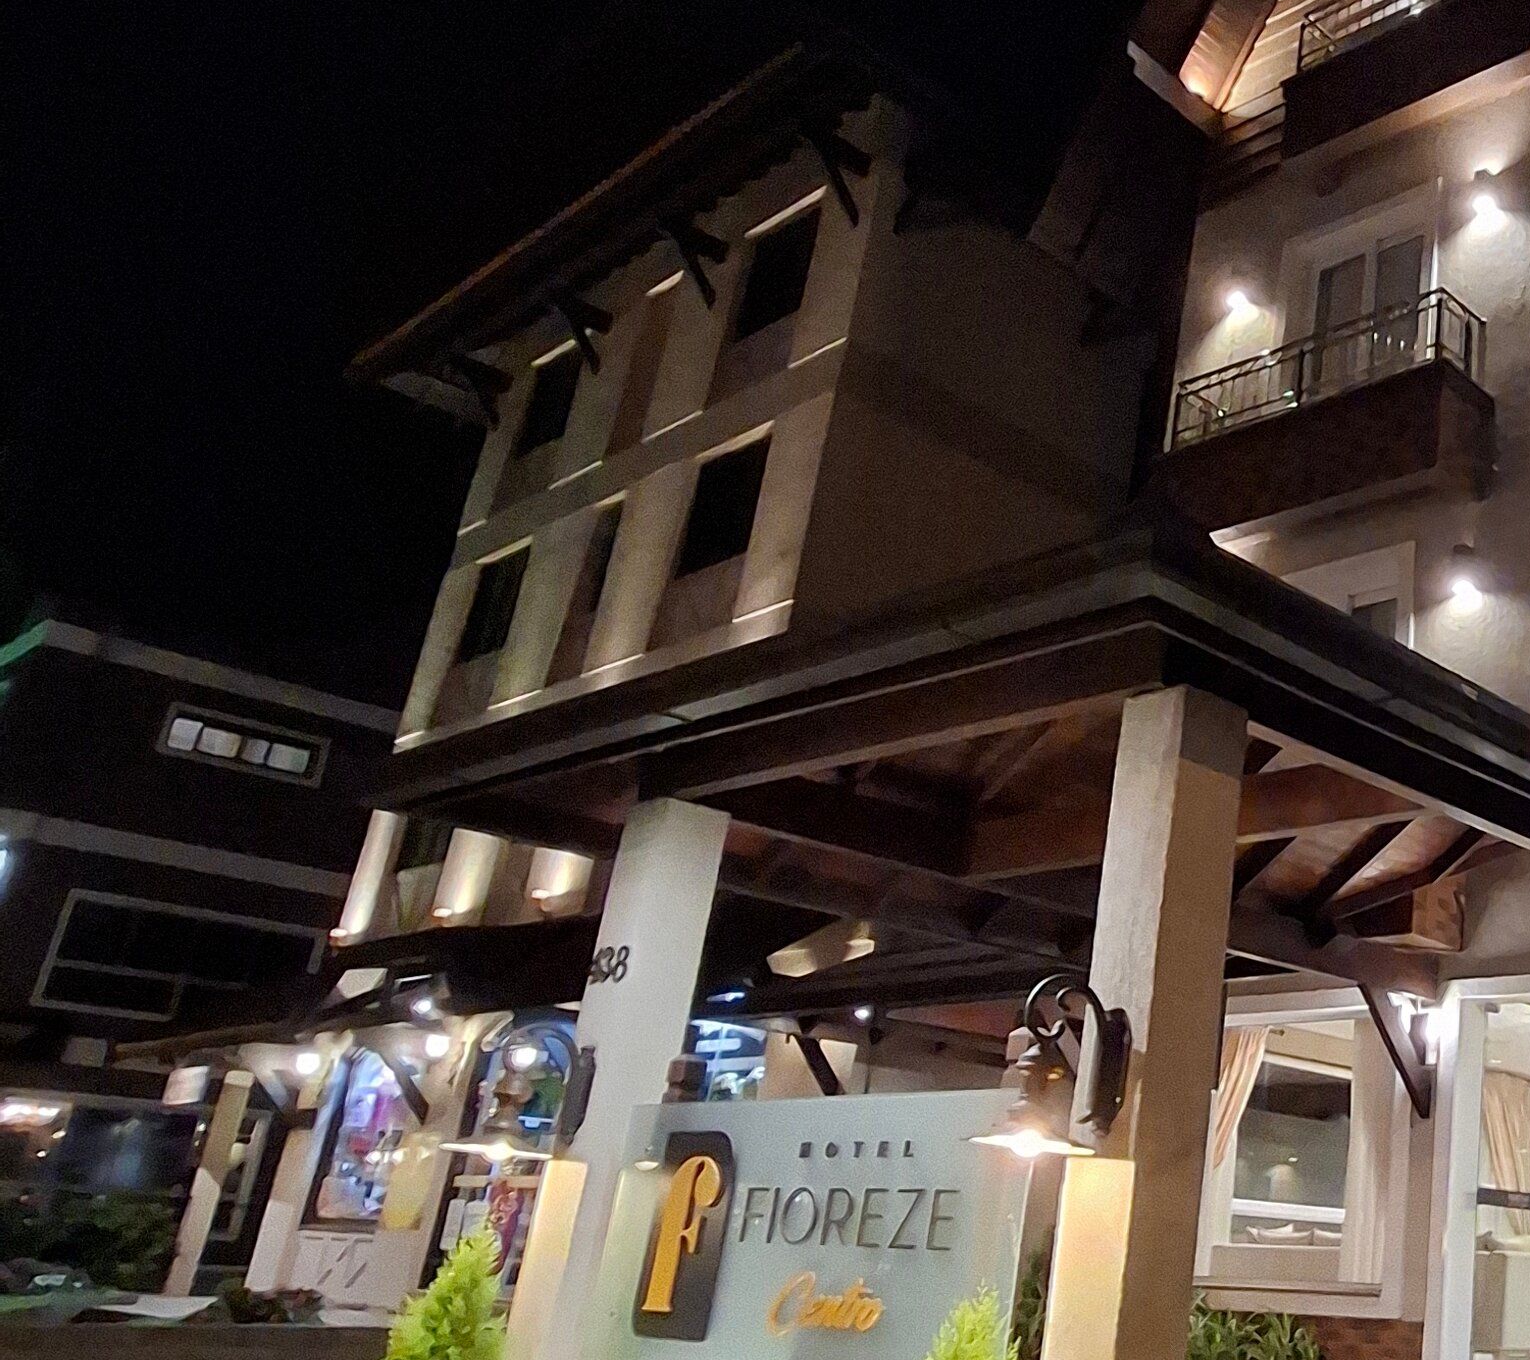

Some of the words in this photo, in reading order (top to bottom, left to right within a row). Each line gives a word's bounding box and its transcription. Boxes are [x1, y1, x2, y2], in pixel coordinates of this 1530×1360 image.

[798, 1140, 914, 1159] HOTEL
[738, 1186, 961, 1252] FIOREZE
[766, 1270, 885, 1337] Centro
